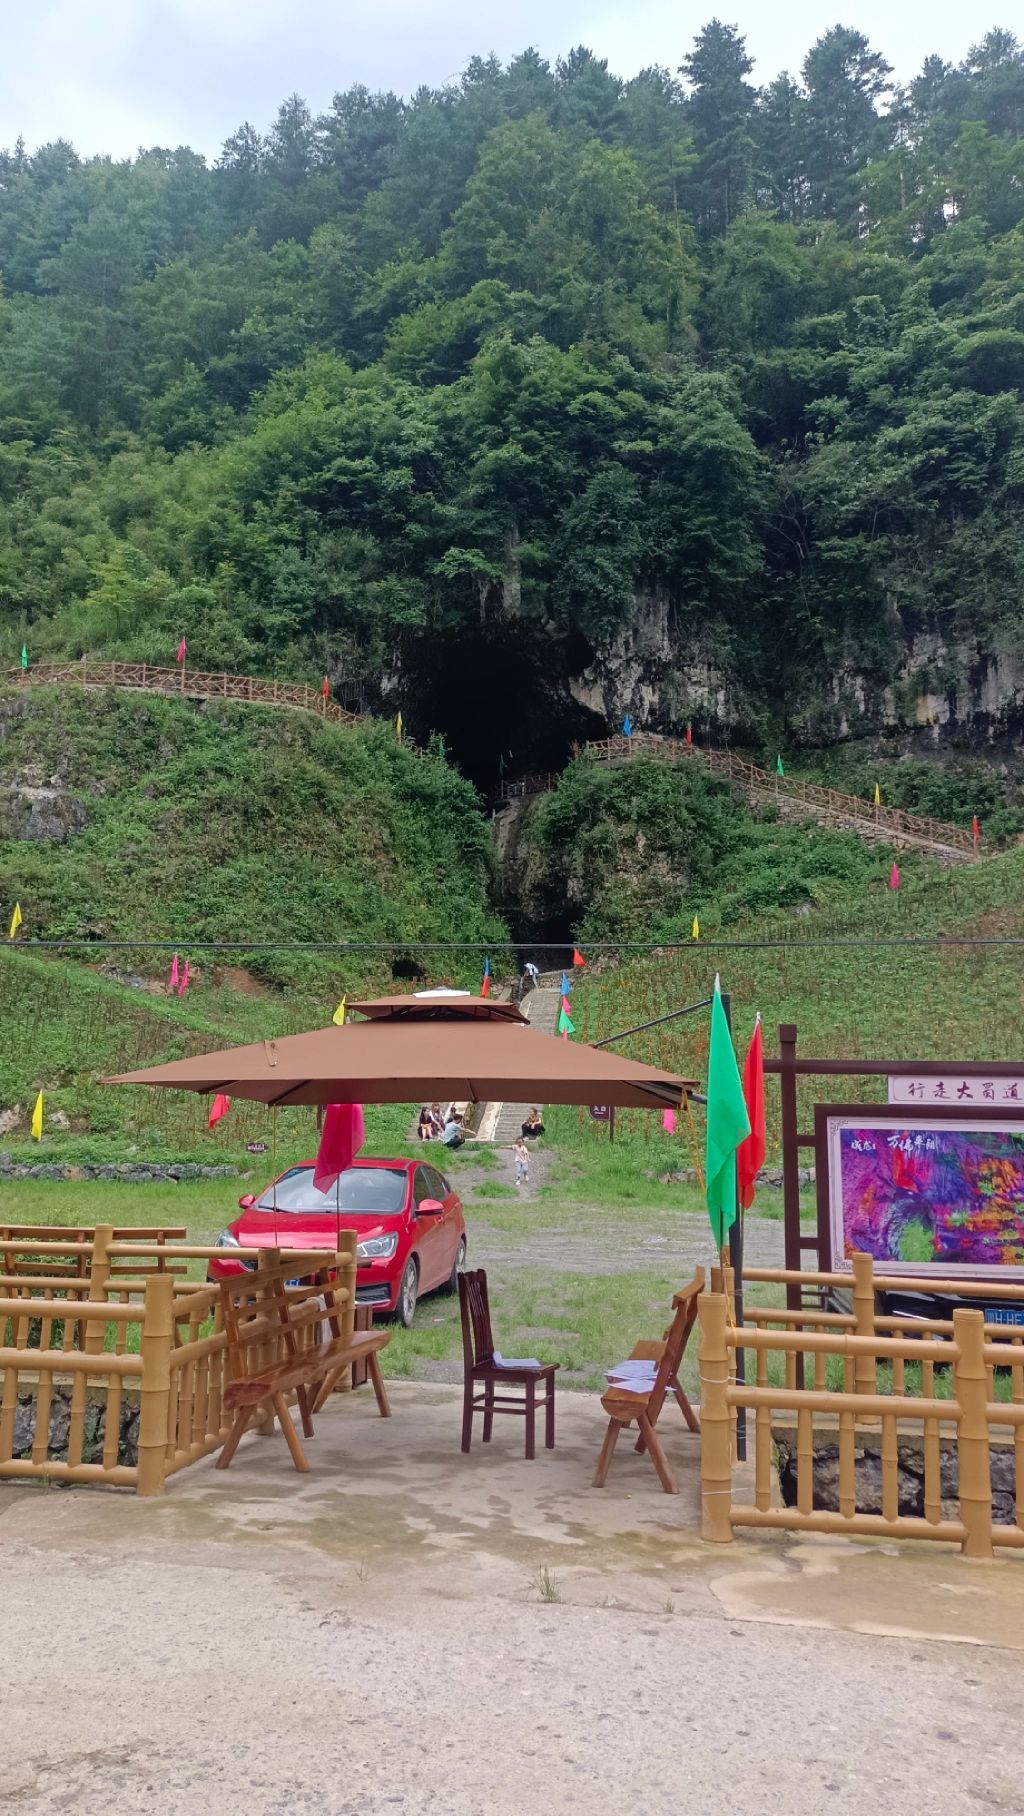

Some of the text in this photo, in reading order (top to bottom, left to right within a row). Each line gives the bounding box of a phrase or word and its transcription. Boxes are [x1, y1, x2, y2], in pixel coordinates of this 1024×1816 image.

[908, 1081, 1023, 1100] 行走大蜀道
